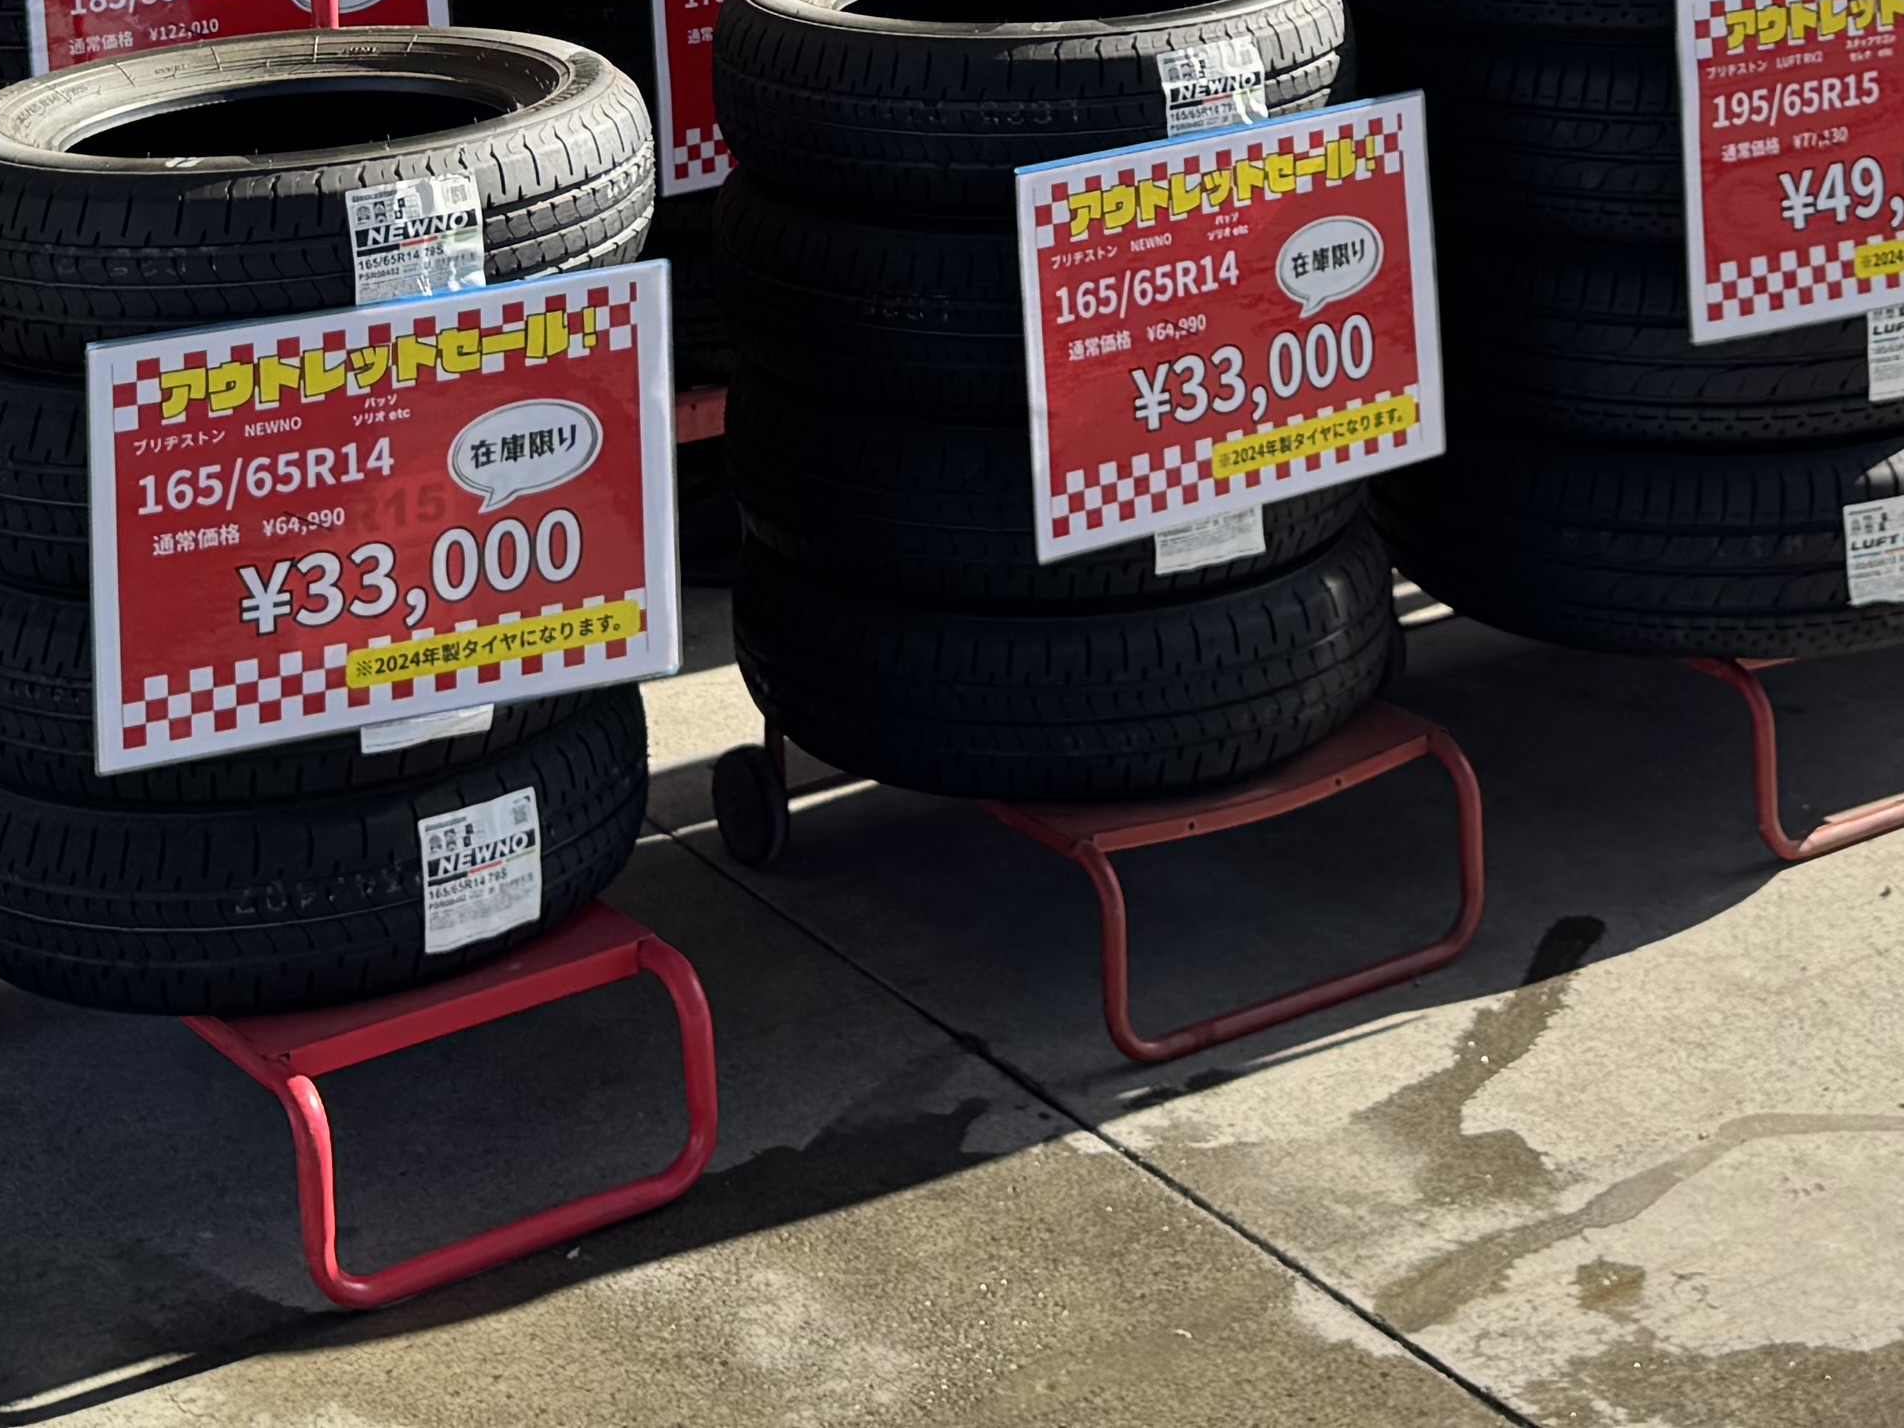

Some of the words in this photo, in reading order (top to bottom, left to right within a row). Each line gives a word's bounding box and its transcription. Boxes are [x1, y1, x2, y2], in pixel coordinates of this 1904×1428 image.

[68, 31, 134, 56] 通常価格
[1178, 72, 1257, 102] NEWNO
[1711, 71, 1881, 129] 195/65R15
[1066, 135, 1377, 238] アウトレットセール!
[367, 211, 468, 245] NEWNO
[357, 247, 420, 271] 165/65R14
[1055, 250, 1240, 325] 165/65R14
[159, 305, 598, 421] アウトレットセール!
[1130, 313, 1375, 433] ¥33,000
[352, 408, 386, 425] ソリオ
[388, 407, 411, 421] etc
[364, 394, 398, 409] パッソ
[132, 428, 226, 456] ブリヂストン
[243, 416, 303, 438] NEWNO
[469, 423, 579, 469] 在庫限り
[137, 436, 395, 516] 165/65R14
[151, 524, 241, 557] 通常価格
[261, 505, 346, 538] ¥64,990
[1850, 533, 1898, 552] LUFT
[237, 508, 584, 637] ¥33,000
[356, 614, 623, 681] ※2024年製タイヤになります。
[436, 832, 529, 876] NEWNO
